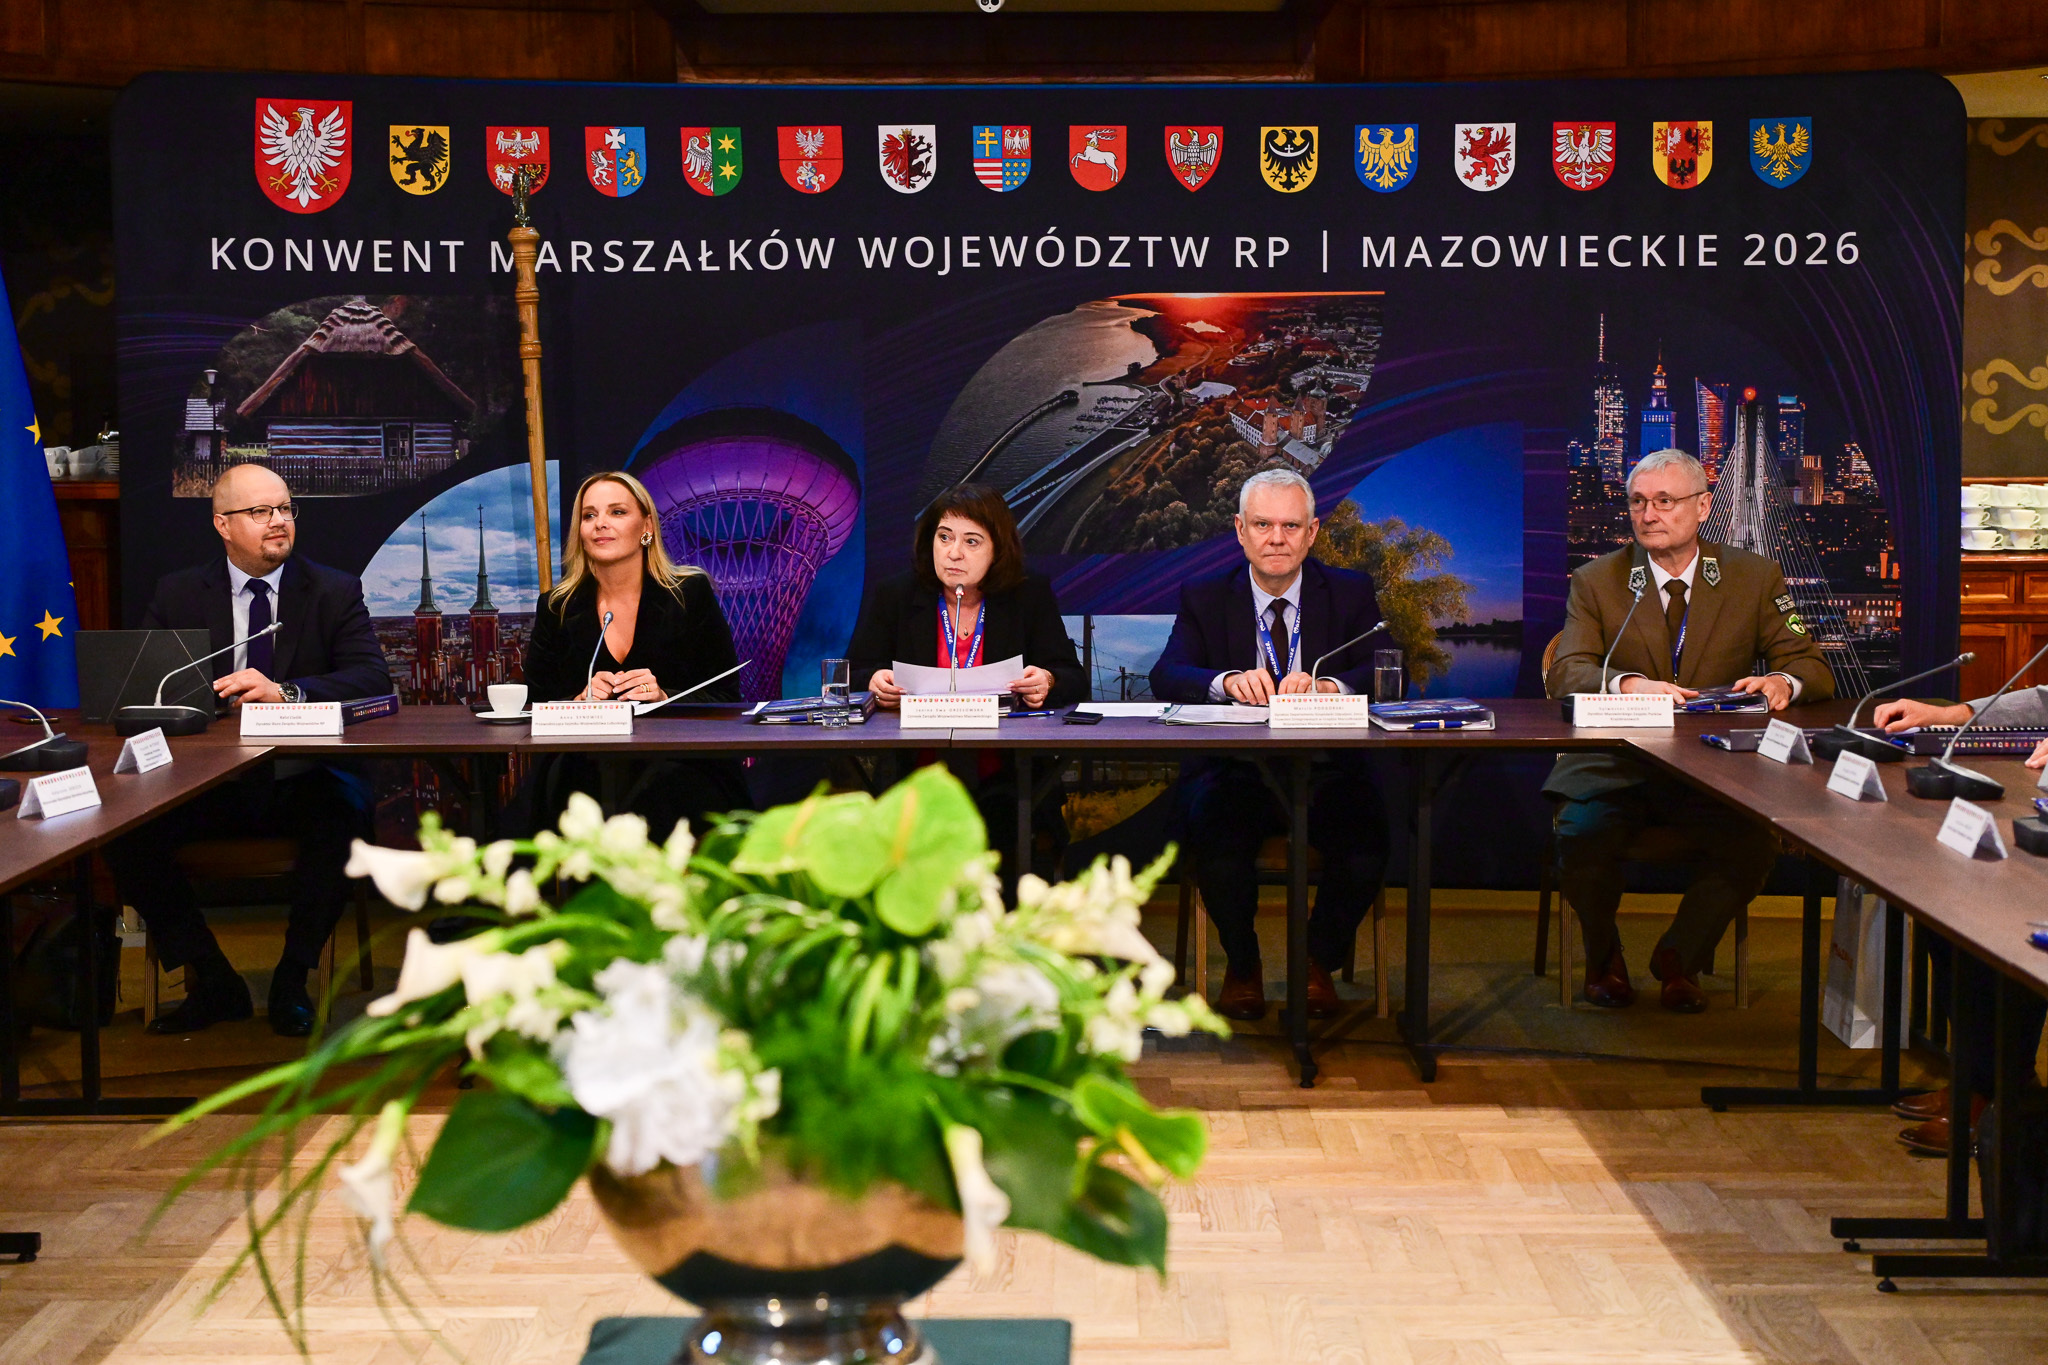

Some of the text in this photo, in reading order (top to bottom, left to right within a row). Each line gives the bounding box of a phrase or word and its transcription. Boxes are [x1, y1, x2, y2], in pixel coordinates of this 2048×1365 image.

[211, 237, 463, 272] KONWENT
[490, 229, 834, 272] MARSZAŁKÓW
[857, 226, 1209, 275] WOJEWÓDZTW
[1235, 236, 1289, 267] RP
[1362, 235, 1717, 267] MAZOWIECKIE
[1743, 232, 1858, 265] 2026
